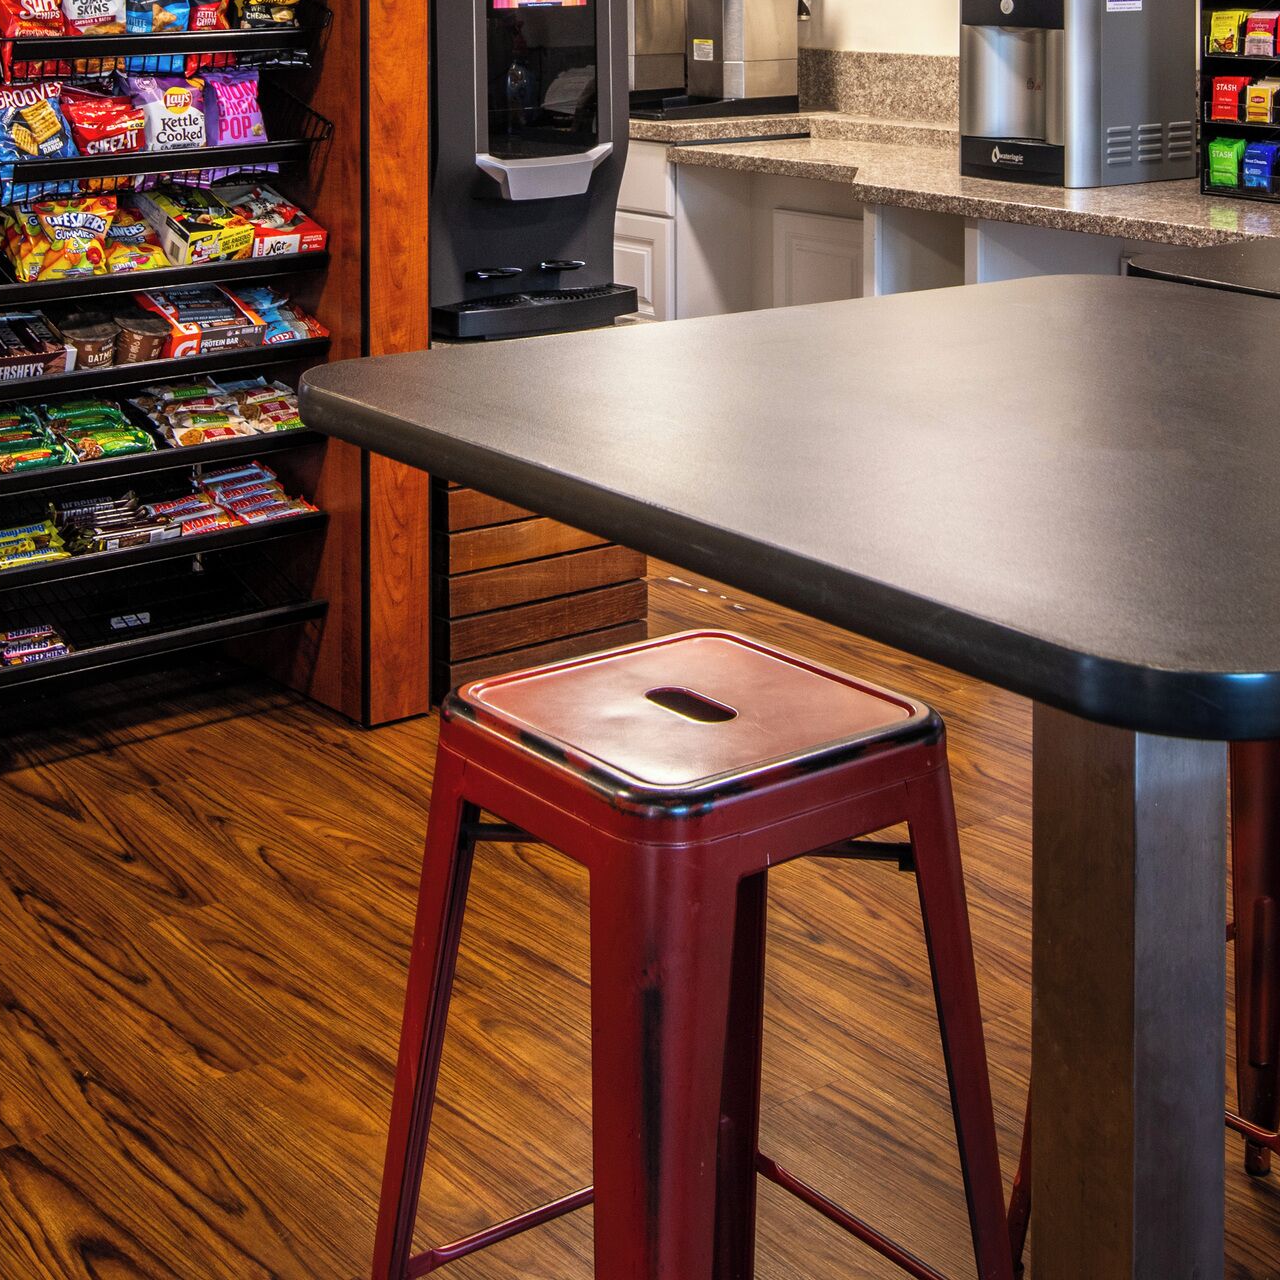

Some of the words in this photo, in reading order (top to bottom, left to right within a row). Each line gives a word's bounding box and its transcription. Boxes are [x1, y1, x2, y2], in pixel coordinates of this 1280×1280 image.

[35, 10, 61, 20] CHIPS
[76, 2, 110, 16] SKINS
[1215, 83, 1238, 92] STASH
[166, 92, 191, 108] Lay's
[160, 113, 199, 132] Kettle
[219, 116, 252, 141] POP
[156, 126, 203, 144] Cooked
[42, 141, 64, 155] RANCH
[1212, 150, 1234, 159] STASH
[55, 228, 95, 240] GUMMIES
[270, 239, 287, 254] Nut
[201, 337, 225, 348] PROTEIN
[225, 336, 240, 345] BAR
[225, 482, 266, 499] PAYDAY
[230, 494, 273, 511] PAYDAY
[8, 624, 53, 638] SNICKERS
[4, 641, 49, 657] SNICKERS
